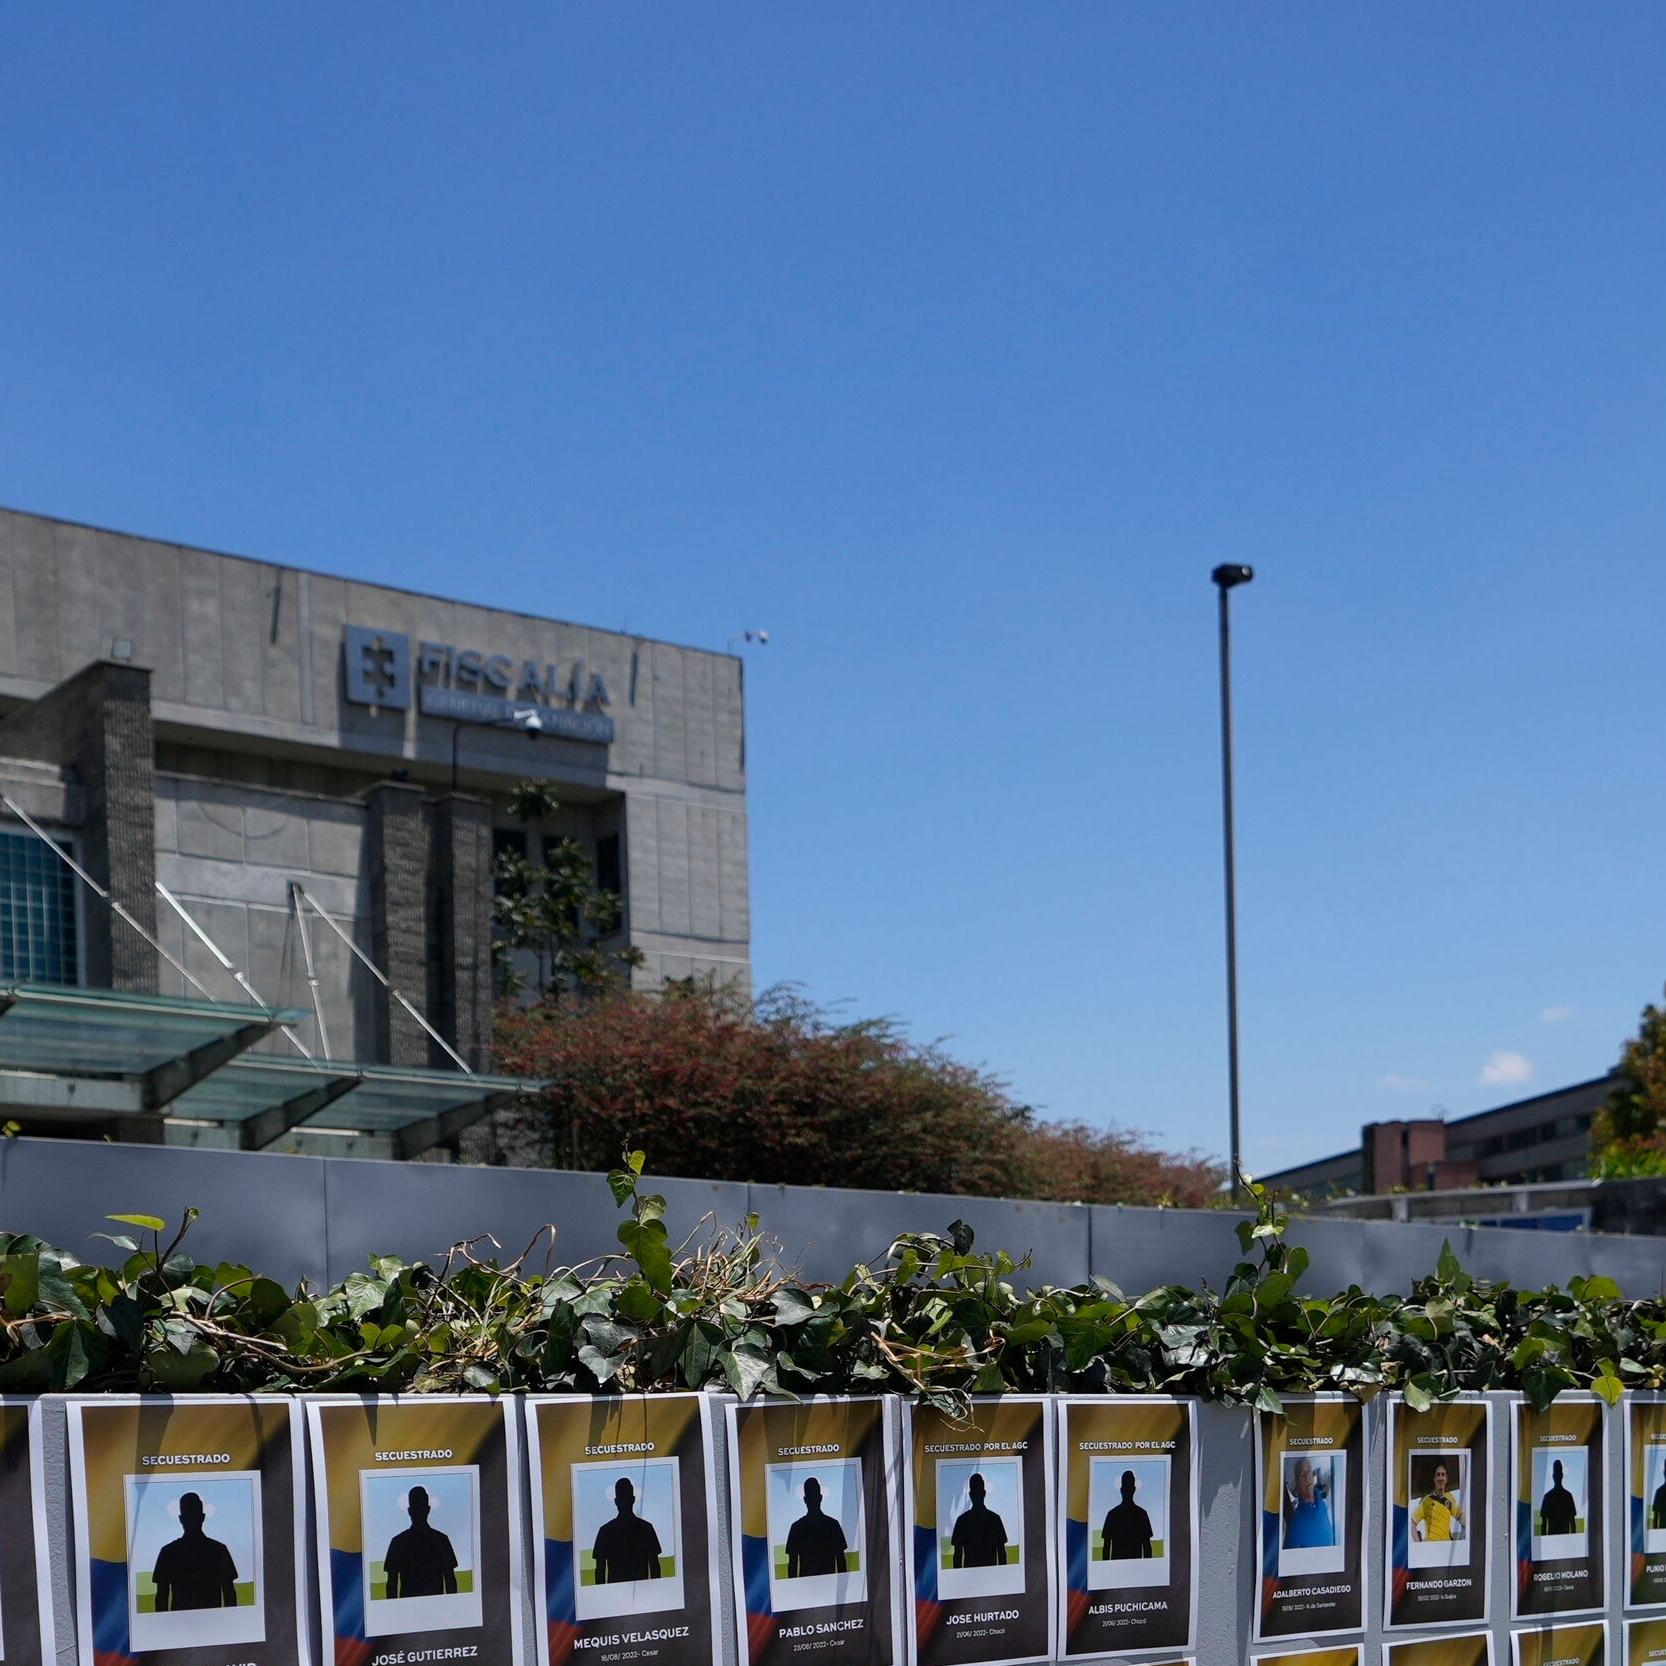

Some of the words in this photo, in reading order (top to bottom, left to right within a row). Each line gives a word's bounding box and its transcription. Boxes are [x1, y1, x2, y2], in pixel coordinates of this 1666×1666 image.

[420, 642, 610, 705] FISCALÍA
[946, 1614, 972, 1625] JOSE
[974, 1610, 1019, 1622] HURTADO
[1088, 1604, 1113, 1615] ALBIS
[1115, 1601, 1168, 1612] PUCHICAMA
[574, 1634, 620, 1649] MEQUIS
[621, 1626, 689, 1643] VELASQUEZ
[779, 1625, 814, 1639] PABLO
[816, 1619, 863, 1634] SANCHEZ
[372, 1650, 405, 1666] JOSÉ
[407, 1645, 478, 1662] GUTIERREZ
